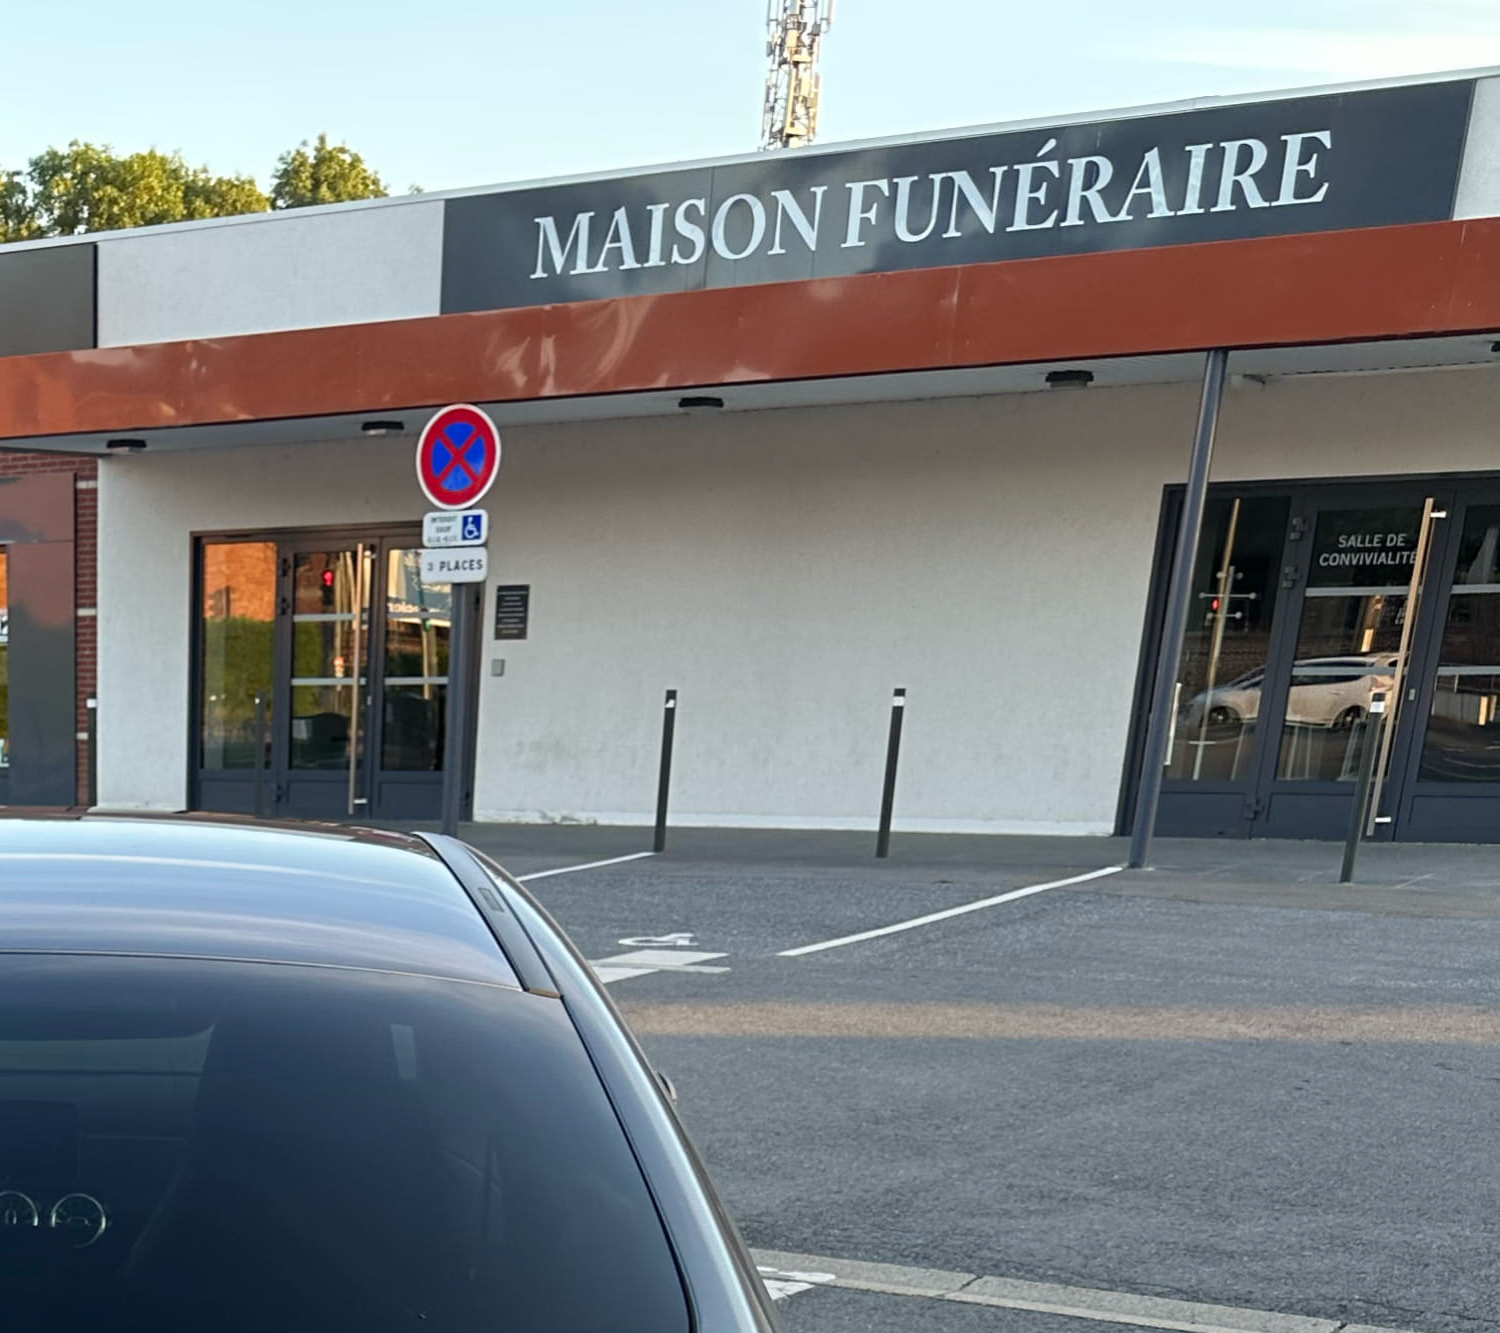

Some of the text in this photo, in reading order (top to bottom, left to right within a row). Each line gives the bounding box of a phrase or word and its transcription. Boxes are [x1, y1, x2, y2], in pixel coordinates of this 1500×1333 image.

[529, 130, 1331, 279] MAISON FUNÉRAIRE
[1338, 533, 1407, 548] SALLE DE
[438, 559, 483, 572] PLACES
